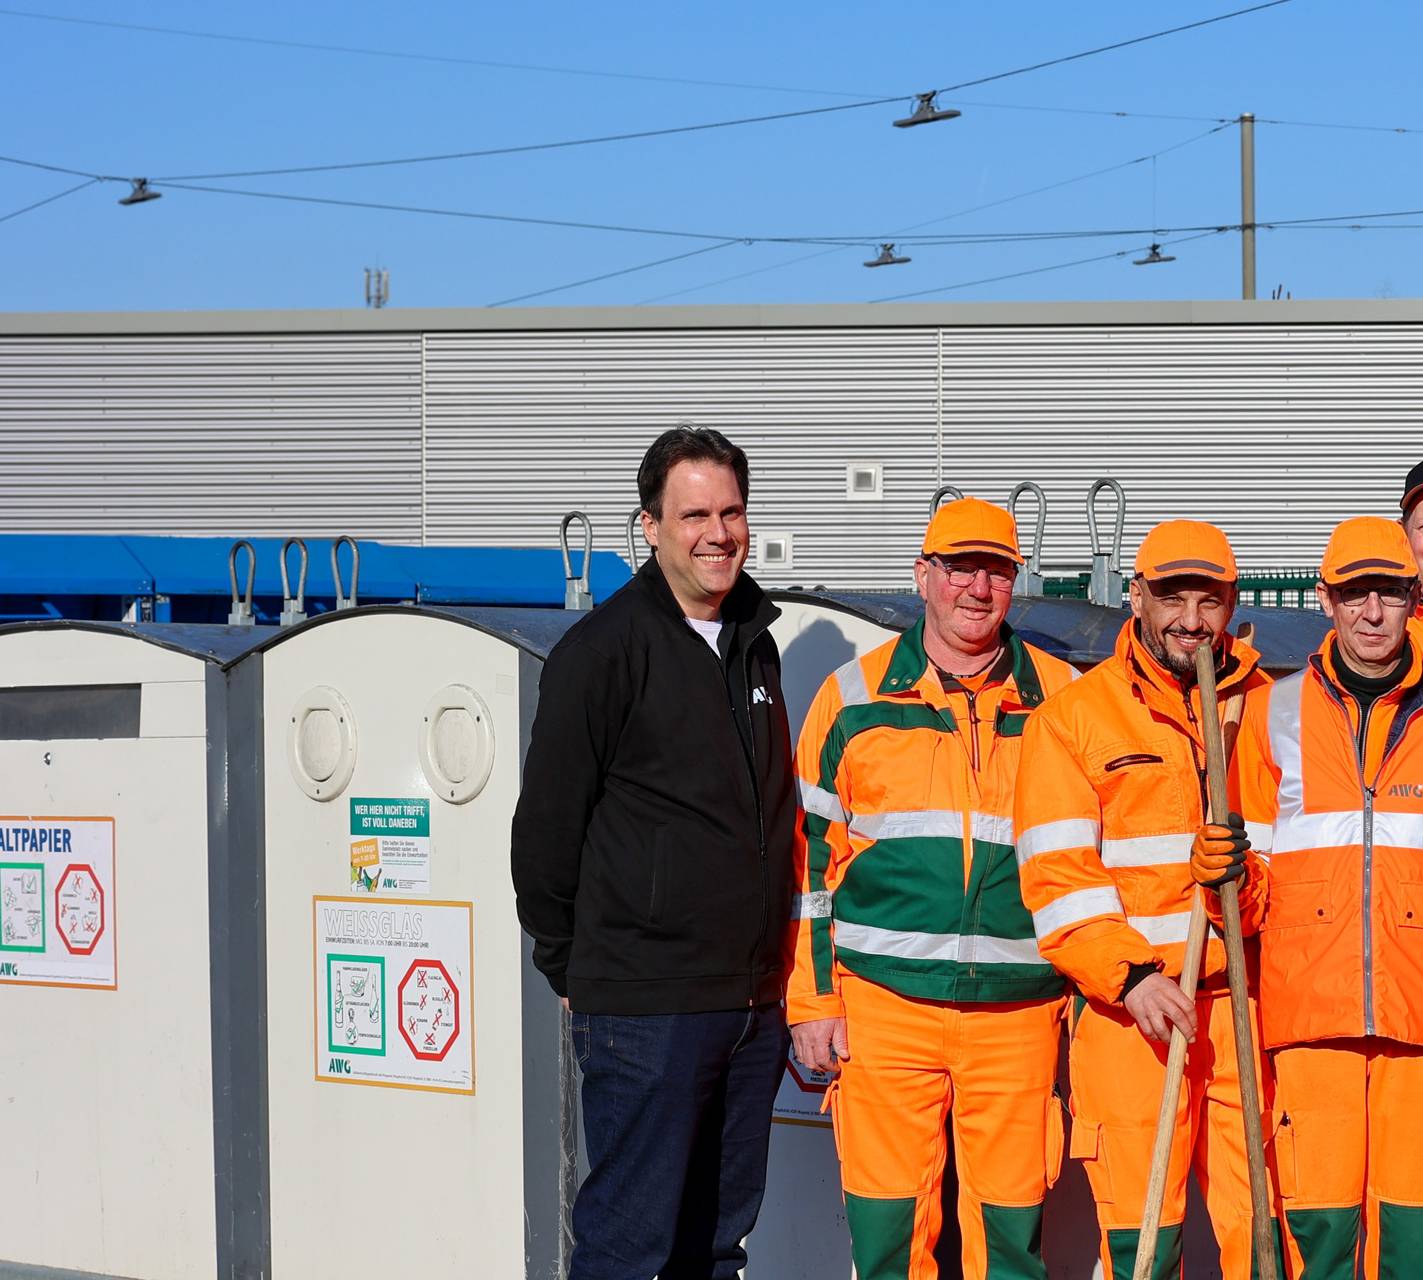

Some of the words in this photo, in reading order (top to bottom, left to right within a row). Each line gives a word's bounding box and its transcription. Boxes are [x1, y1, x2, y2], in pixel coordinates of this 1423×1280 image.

[1388, 783, 1423, 798] AWG
[354, 805, 368, 815] WER
[369, 805, 383, 815] HIER
[384, 805, 402, 816] NICHT
[403, 806, 425, 817] TRIFFT,
[362, 817, 371, 828] IST
[372, 818, 387, 828] VOLL
[388, 818, 417, 828] DANEBEN
[382, 878, 398, 888] AWG
[324, 908, 423, 940] WEISSGLAS
[328, 1058, 352, 1074] AWG
